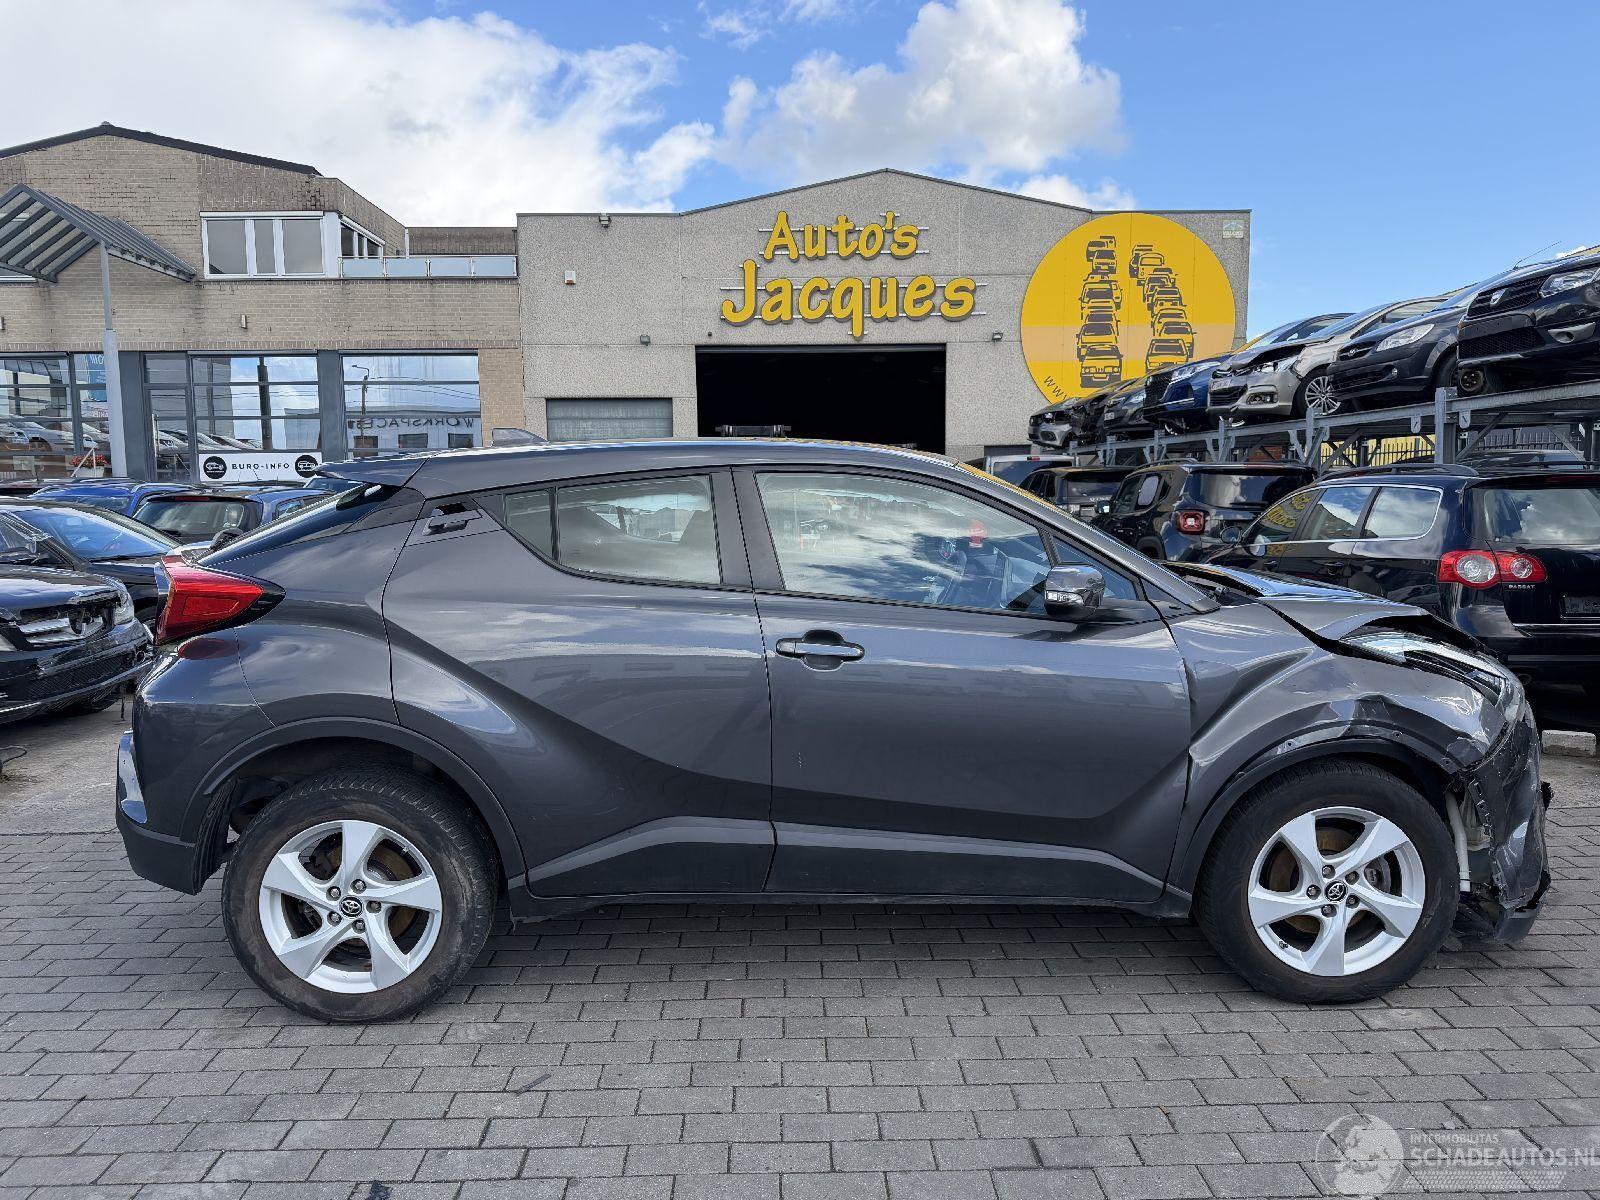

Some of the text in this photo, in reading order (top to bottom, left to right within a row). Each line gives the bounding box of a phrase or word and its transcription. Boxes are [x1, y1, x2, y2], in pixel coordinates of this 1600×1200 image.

[764, 211, 919, 261] Auto's
[721, 258, 976, 338] Jacques
[231, 462, 290, 471] BURO-INFO
